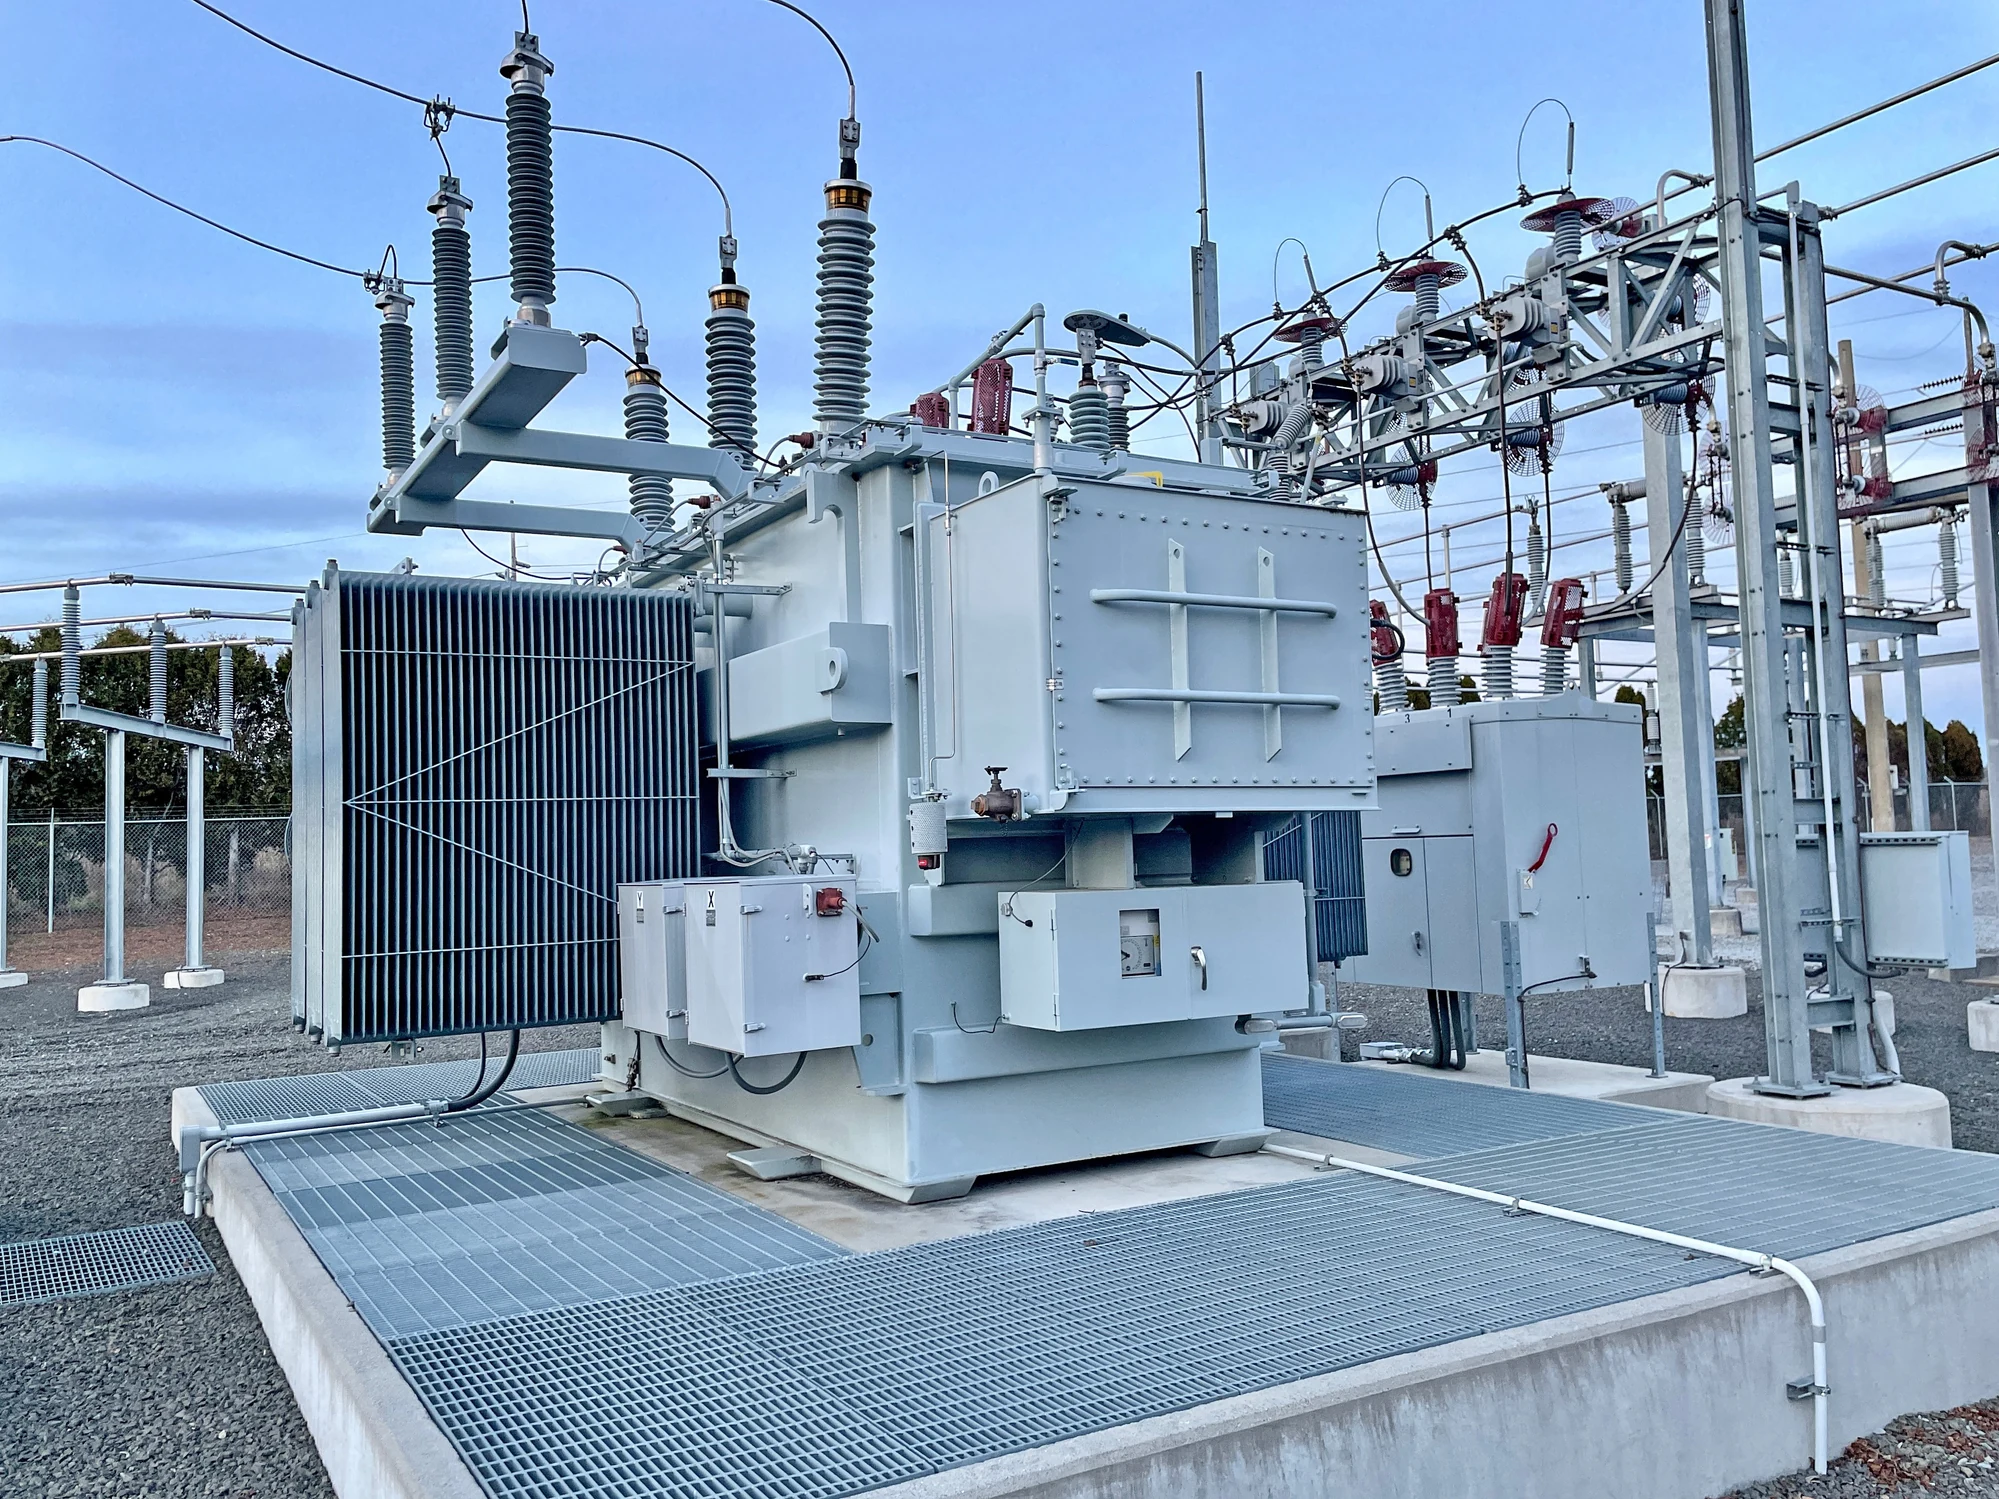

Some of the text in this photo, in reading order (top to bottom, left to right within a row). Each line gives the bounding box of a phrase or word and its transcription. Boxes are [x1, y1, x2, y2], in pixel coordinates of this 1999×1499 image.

[1404, 713, 1411, 723] 3
[1447, 708, 1452, 718] 1
[637, 892, 643, 907] Y
[708, 890, 715, 908] X
